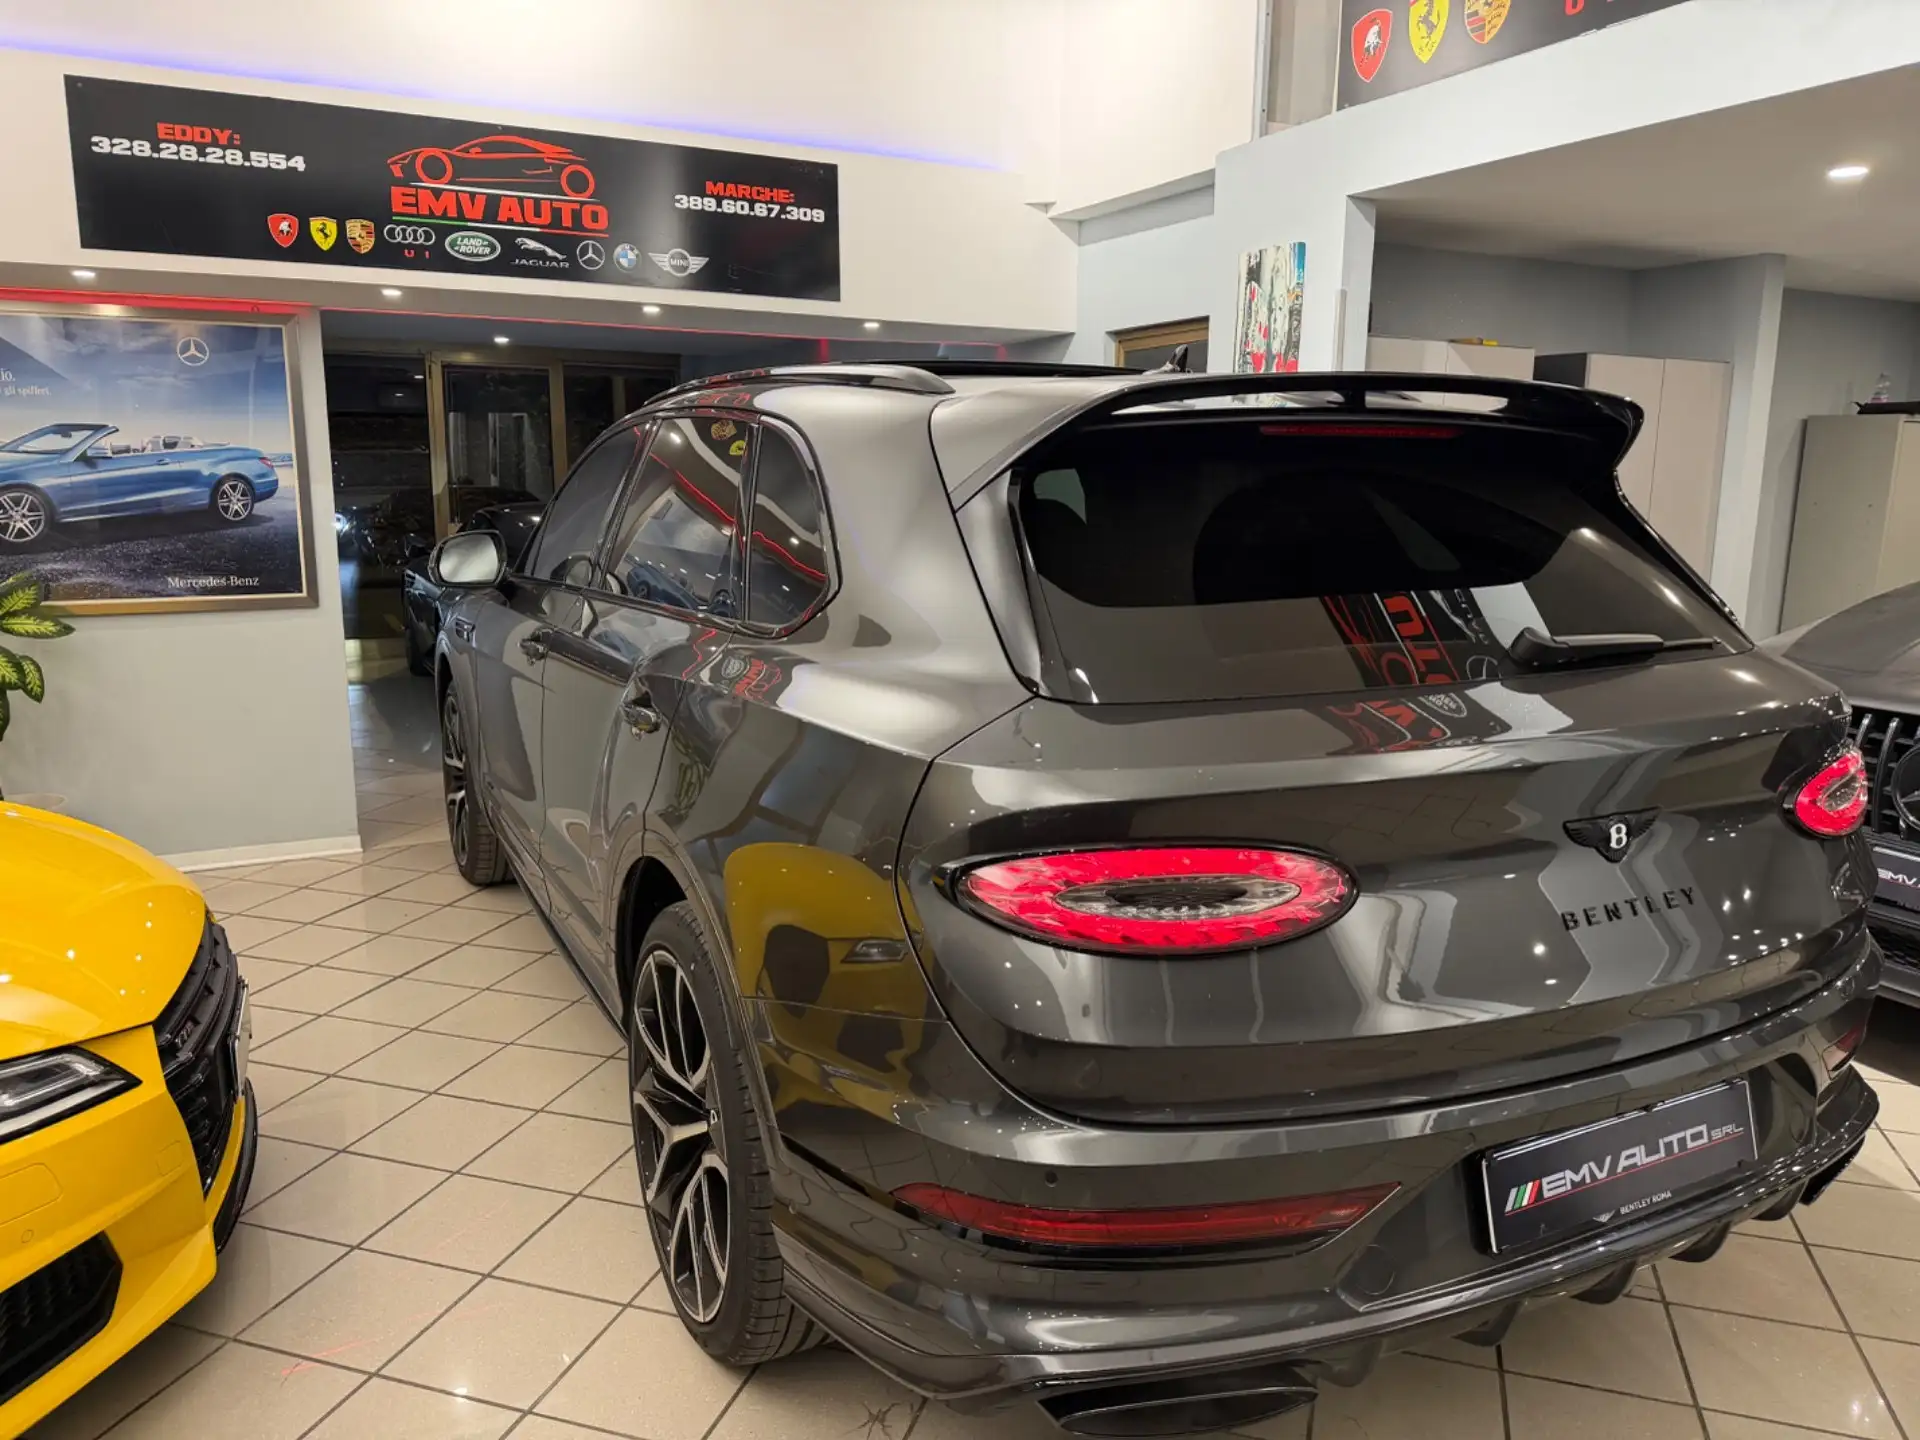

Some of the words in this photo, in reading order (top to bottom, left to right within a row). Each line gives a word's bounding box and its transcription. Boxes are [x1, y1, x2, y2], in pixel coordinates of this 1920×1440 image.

[157, 122, 241, 146] EDDY:
[91, 136, 306, 171] 328.28.28.554
[705, 181, 795, 203] MARCHE:
[391, 186, 487, 220] EMV
[497, 196, 609, 230] AUTO
[674, 194, 825, 223] 389.60.67.309
[456, 236, 482, 247] LAND
[459, 244, 491, 256] ROVER
[510, 258, 570, 269] JAGUAR
[164, 575, 260, 589] Mercedes-Benz
[1609, 823, 1628, 849] B
[1561, 886, 1694, 931] BENTLEY
[1541, 1155, 1612, 1199] EMV
[1616, 1123, 1709, 1173] AUTO
[1711, 1123, 1744, 1141] SRL
[1619, 1196, 1651, 1215] BENTLEY
[1652, 1189, 1672, 1204] ROMA
